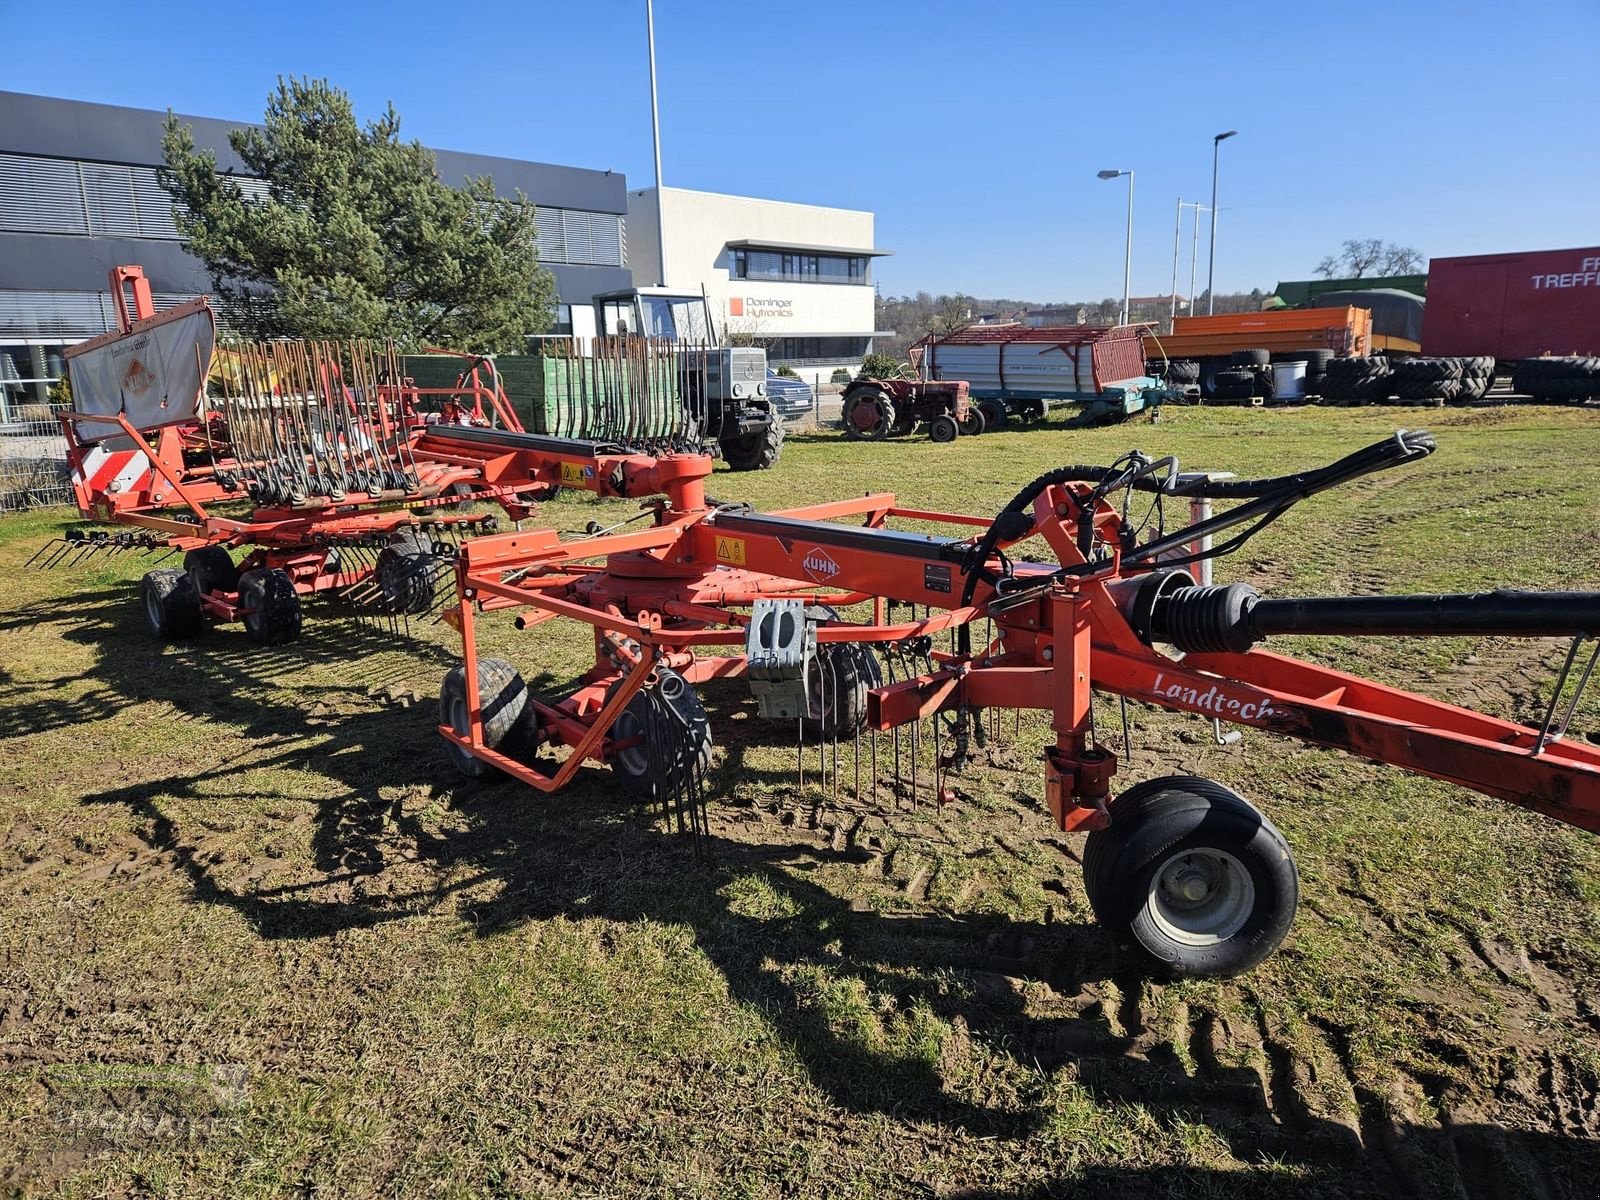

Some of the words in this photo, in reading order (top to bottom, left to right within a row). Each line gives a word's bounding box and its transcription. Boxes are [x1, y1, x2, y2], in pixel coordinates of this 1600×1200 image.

[1532, 271, 1600, 289] TREFF
[746, 307, 794, 319] Hytronics
[803, 556, 836, 576] KUHN
